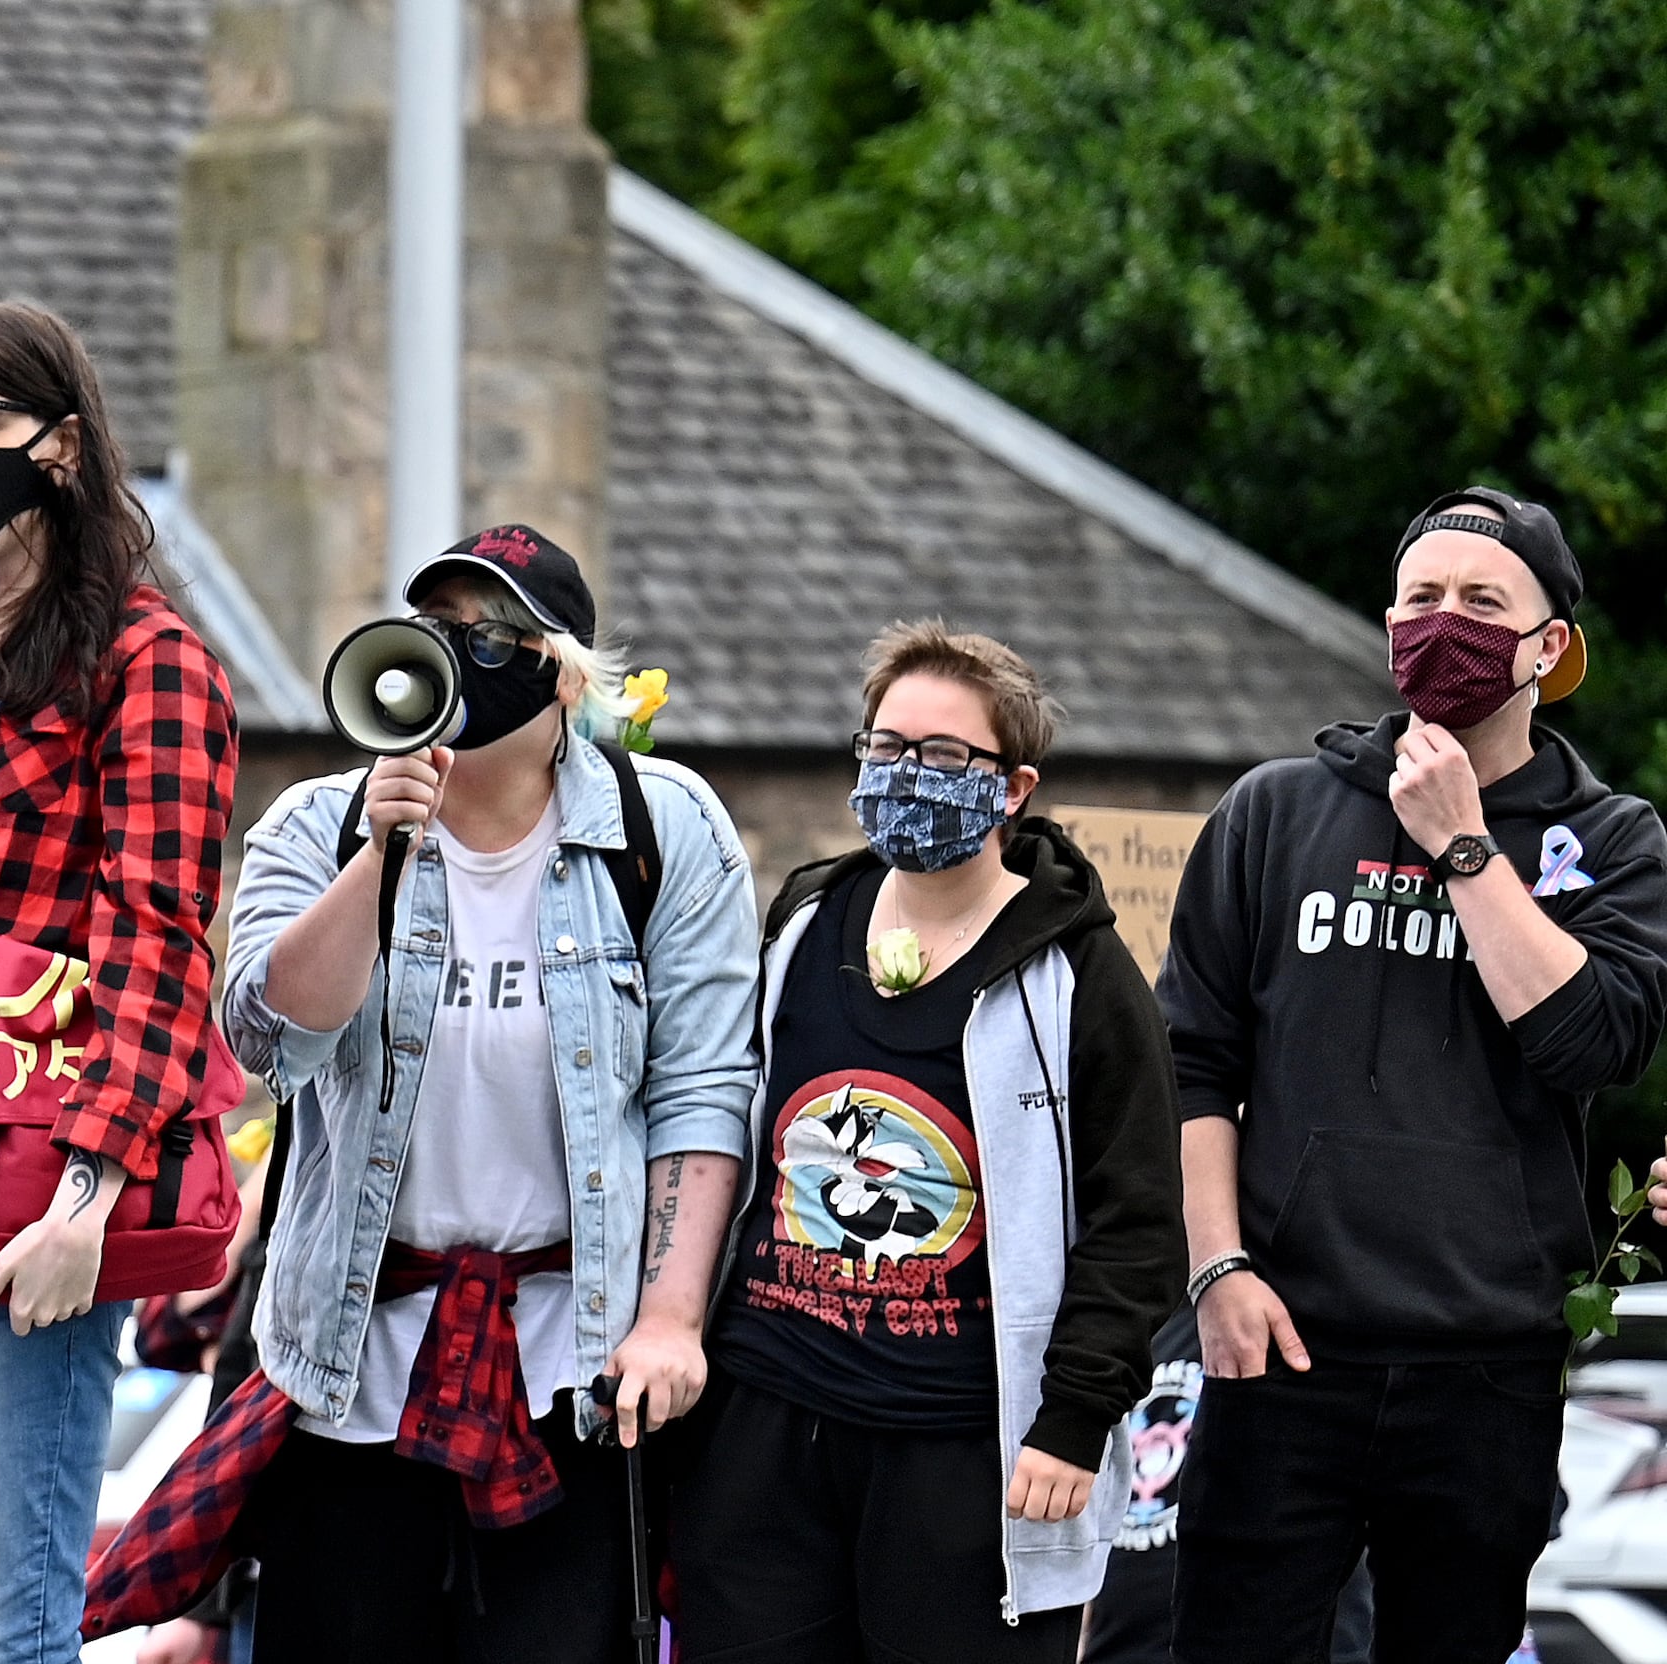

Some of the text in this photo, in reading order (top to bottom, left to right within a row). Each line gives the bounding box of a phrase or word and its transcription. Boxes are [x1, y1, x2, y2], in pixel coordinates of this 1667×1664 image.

[1367, 870, 1424, 895] NOT
[1297, 891, 1475, 961] COLON
[856, 1257, 951, 1298] LAST
[884, 1299, 960, 1337] CAT
